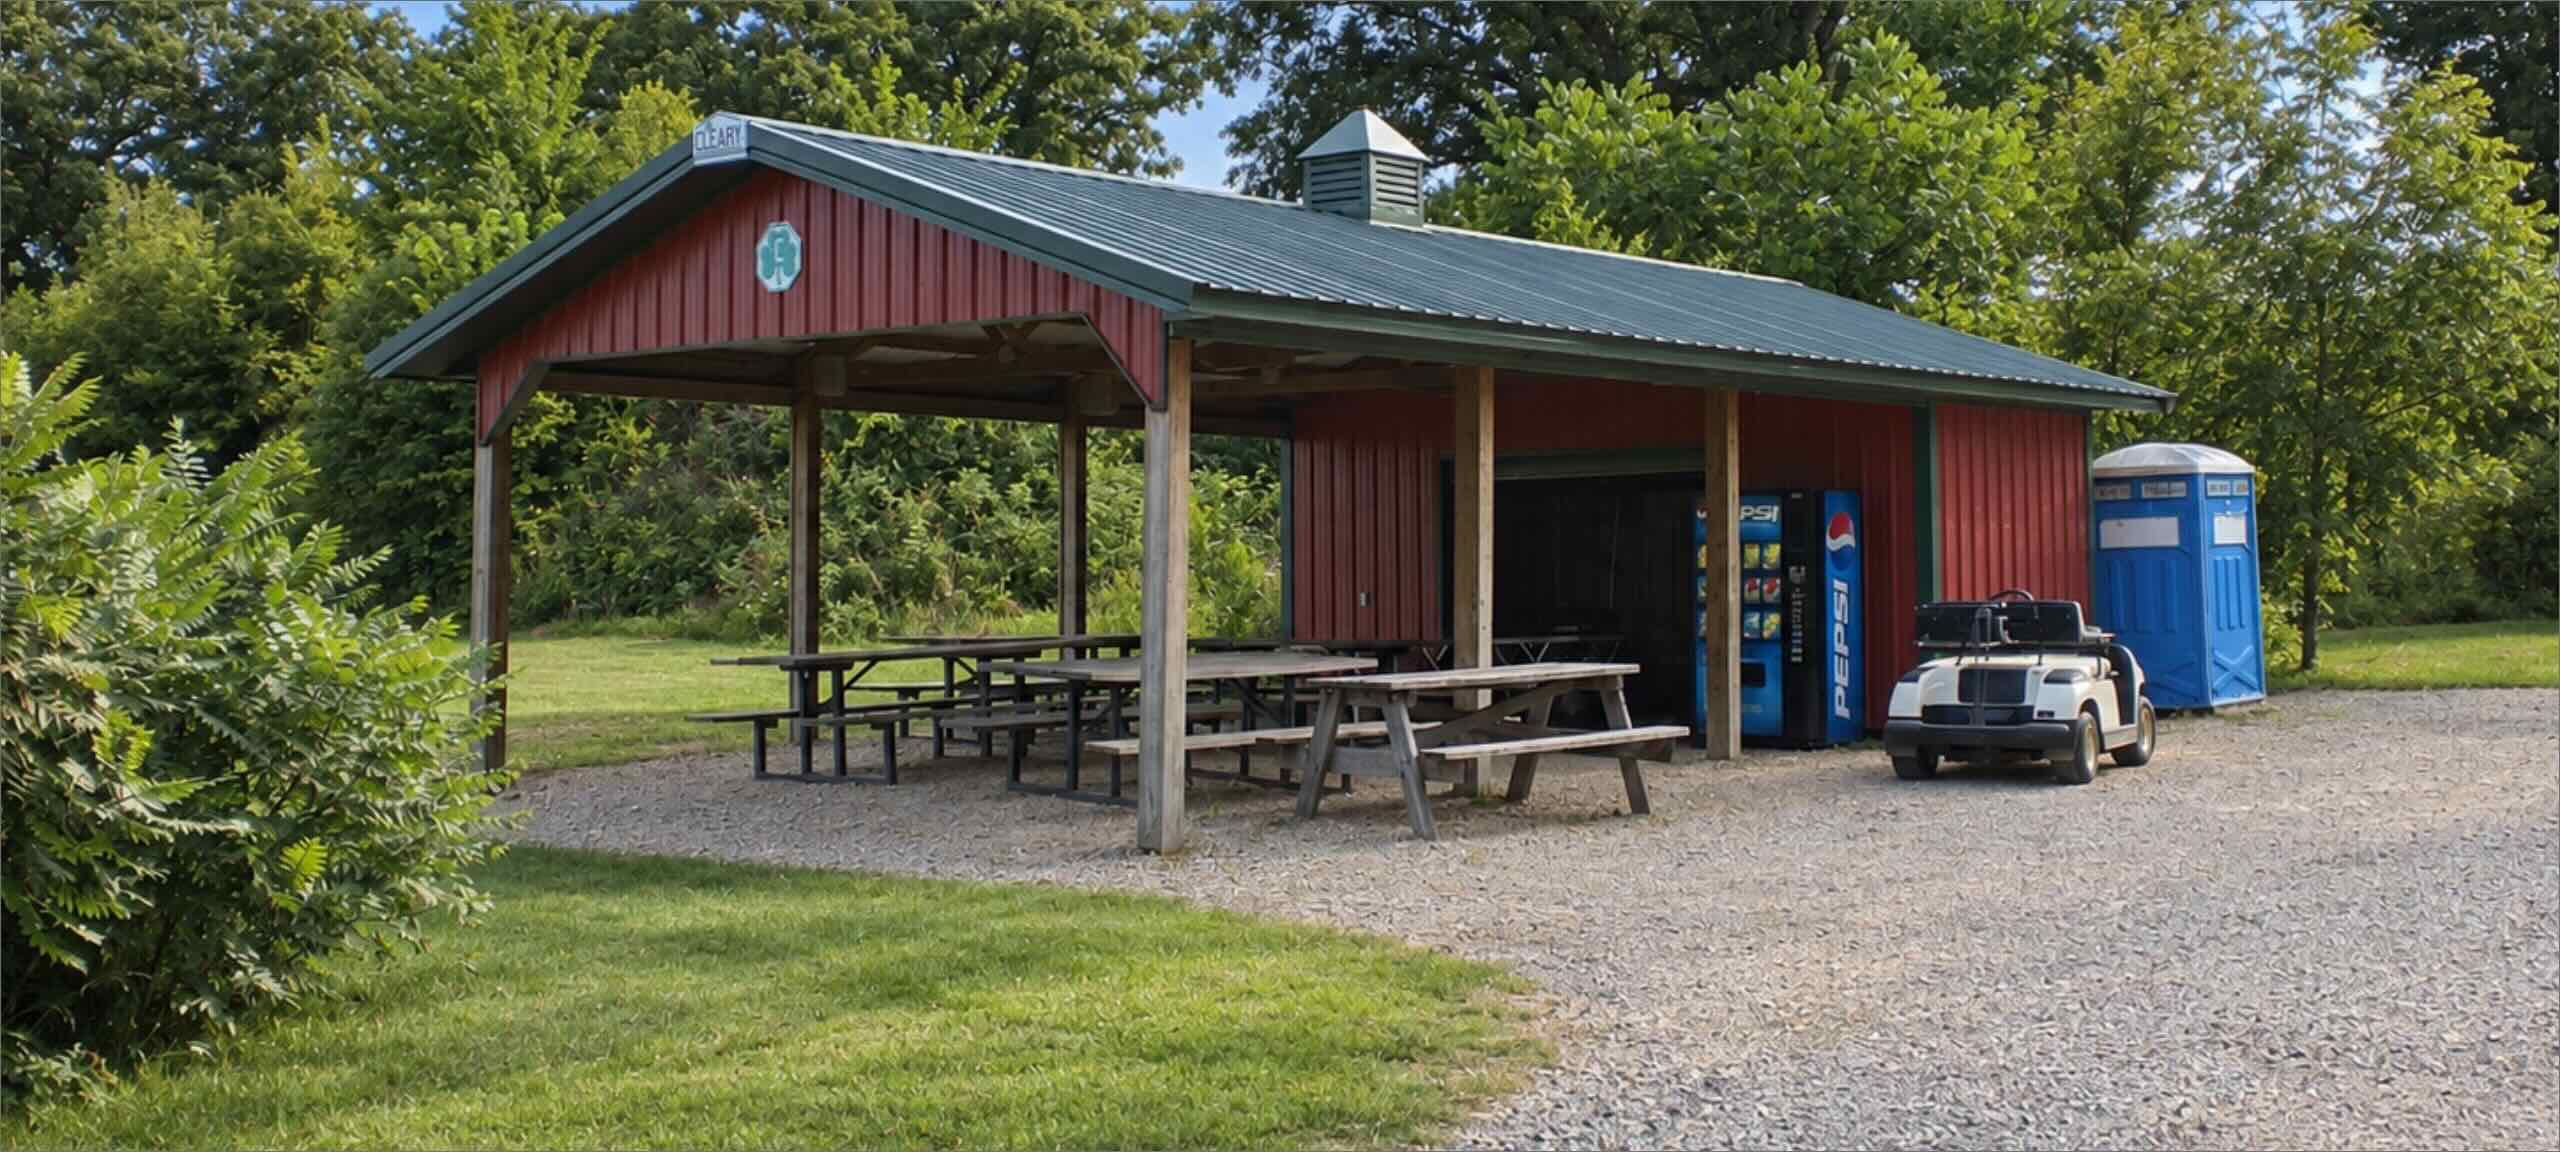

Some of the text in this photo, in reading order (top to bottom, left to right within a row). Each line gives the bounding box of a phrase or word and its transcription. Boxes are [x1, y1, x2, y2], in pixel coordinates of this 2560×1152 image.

[695, 126, 742, 151] CLEARY
[1739, 505, 1779, 522] PSI
[1833, 578, 1850, 720] PEPSI
